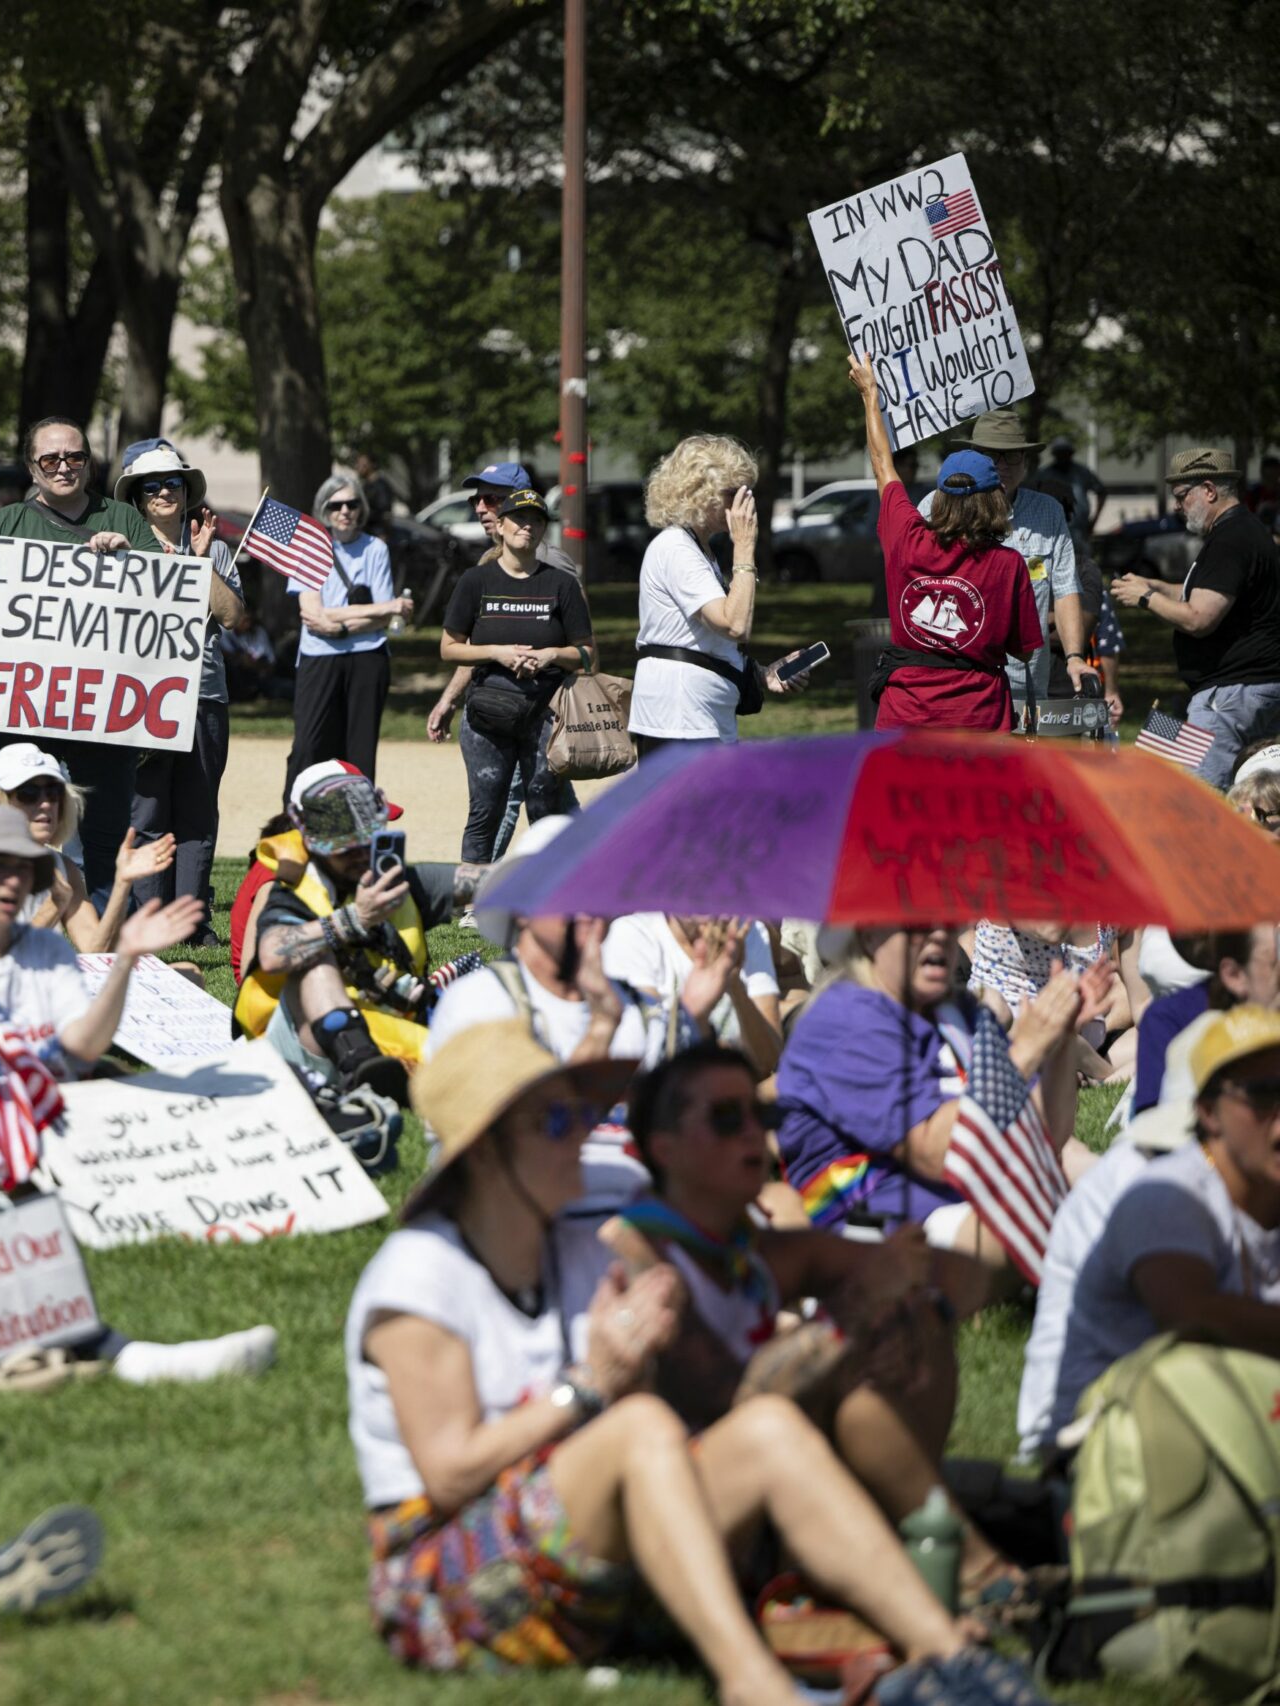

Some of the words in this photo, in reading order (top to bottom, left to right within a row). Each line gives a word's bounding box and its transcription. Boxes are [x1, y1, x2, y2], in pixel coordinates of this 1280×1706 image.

[823, 198, 866, 243] IN
[870, 169, 949, 222] WW2
[897, 228, 995, 291] DAD
[844, 294, 929, 366] FOUGHT
[892, 347, 920, 401] I
[888, 383, 976, 451] HAVE
[971, 370, 1015, 412] TO
[21, 542, 202, 603] DESERVE
[912, 579, 940, 591] ILLEGAL
[942, 579, 980, 609] IMMIGRATION
[1, 593, 203, 662] SENATORS
[486, 603, 499, 612] BE
[502, 603, 550, 613] GENUINE
[104, 673, 190, 740] DC
[566, 720, 602, 733] eusable
[587, 702, 593, 713] I
[104, 1108, 149, 1139] you
[167, 1094, 220, 1119] ever
[76, 1132, 202, 1166] wondered
[227, 1119, 280, 1143] what
[93, 1170, 136, 1197] you
[185, 1192, 289, 1225] DOING
[301, 1166, 345, 1200] IT
[12, 1228, 64, 1266] Our
[180, 1211, 296, 1245] OW
